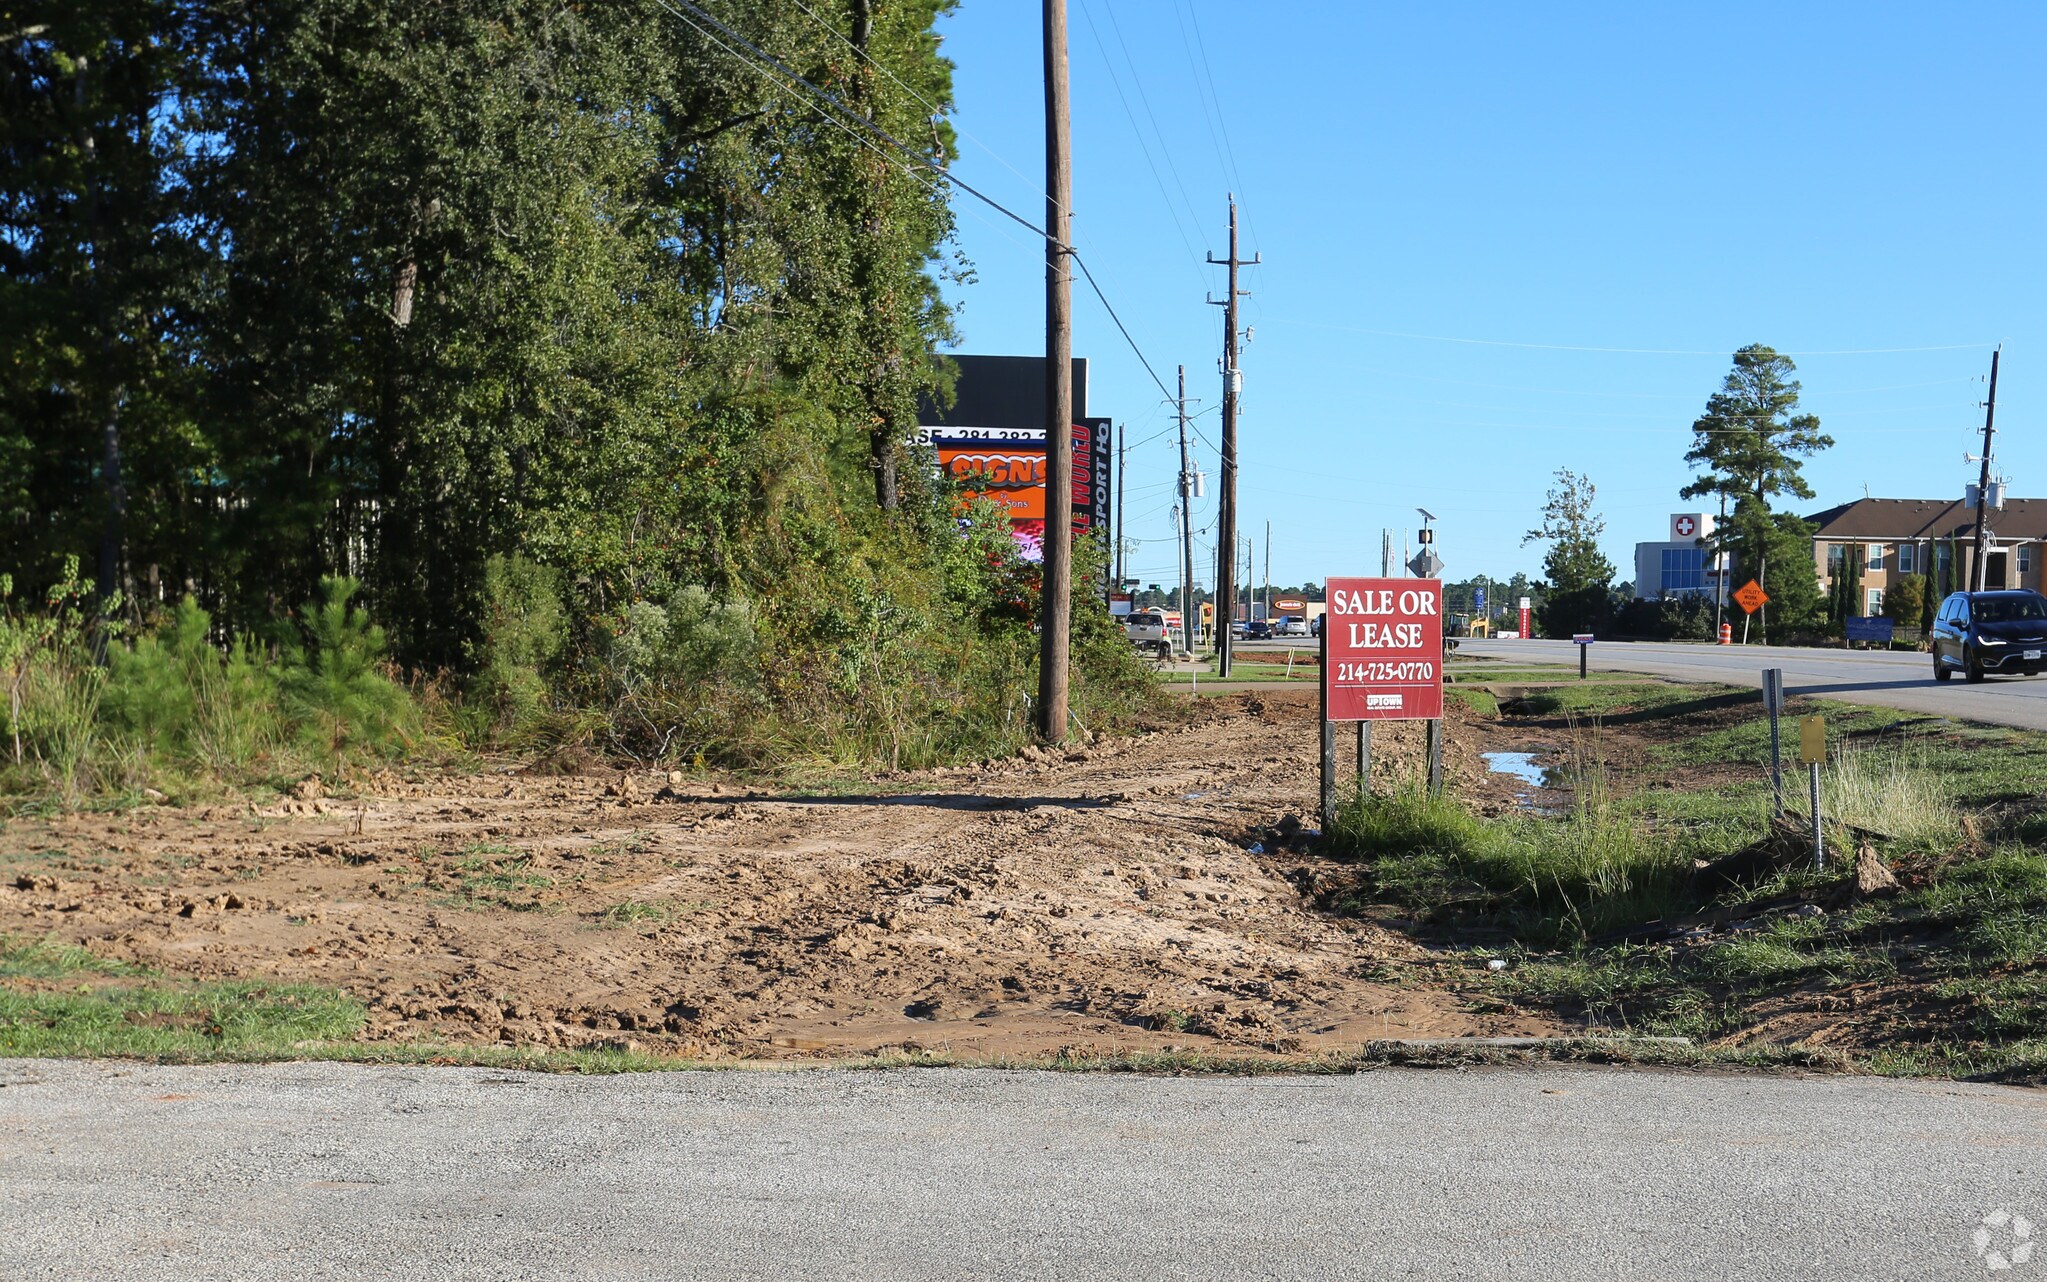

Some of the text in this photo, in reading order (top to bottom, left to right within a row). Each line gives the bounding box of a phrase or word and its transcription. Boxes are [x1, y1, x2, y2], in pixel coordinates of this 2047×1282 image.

[1096, 422, 1109, 455] HQ
[951, 457, 1046, 484] SIGNS
[1005, 499, 1029, 508] Sons
[1334, 590, 1437, 615] SALE OR
[1349, 623, 1424, 649] LEASE
[1337, 662, 1433, 682] 214-725-0770
[1367, 697, 1402, 706] UPTOWN
